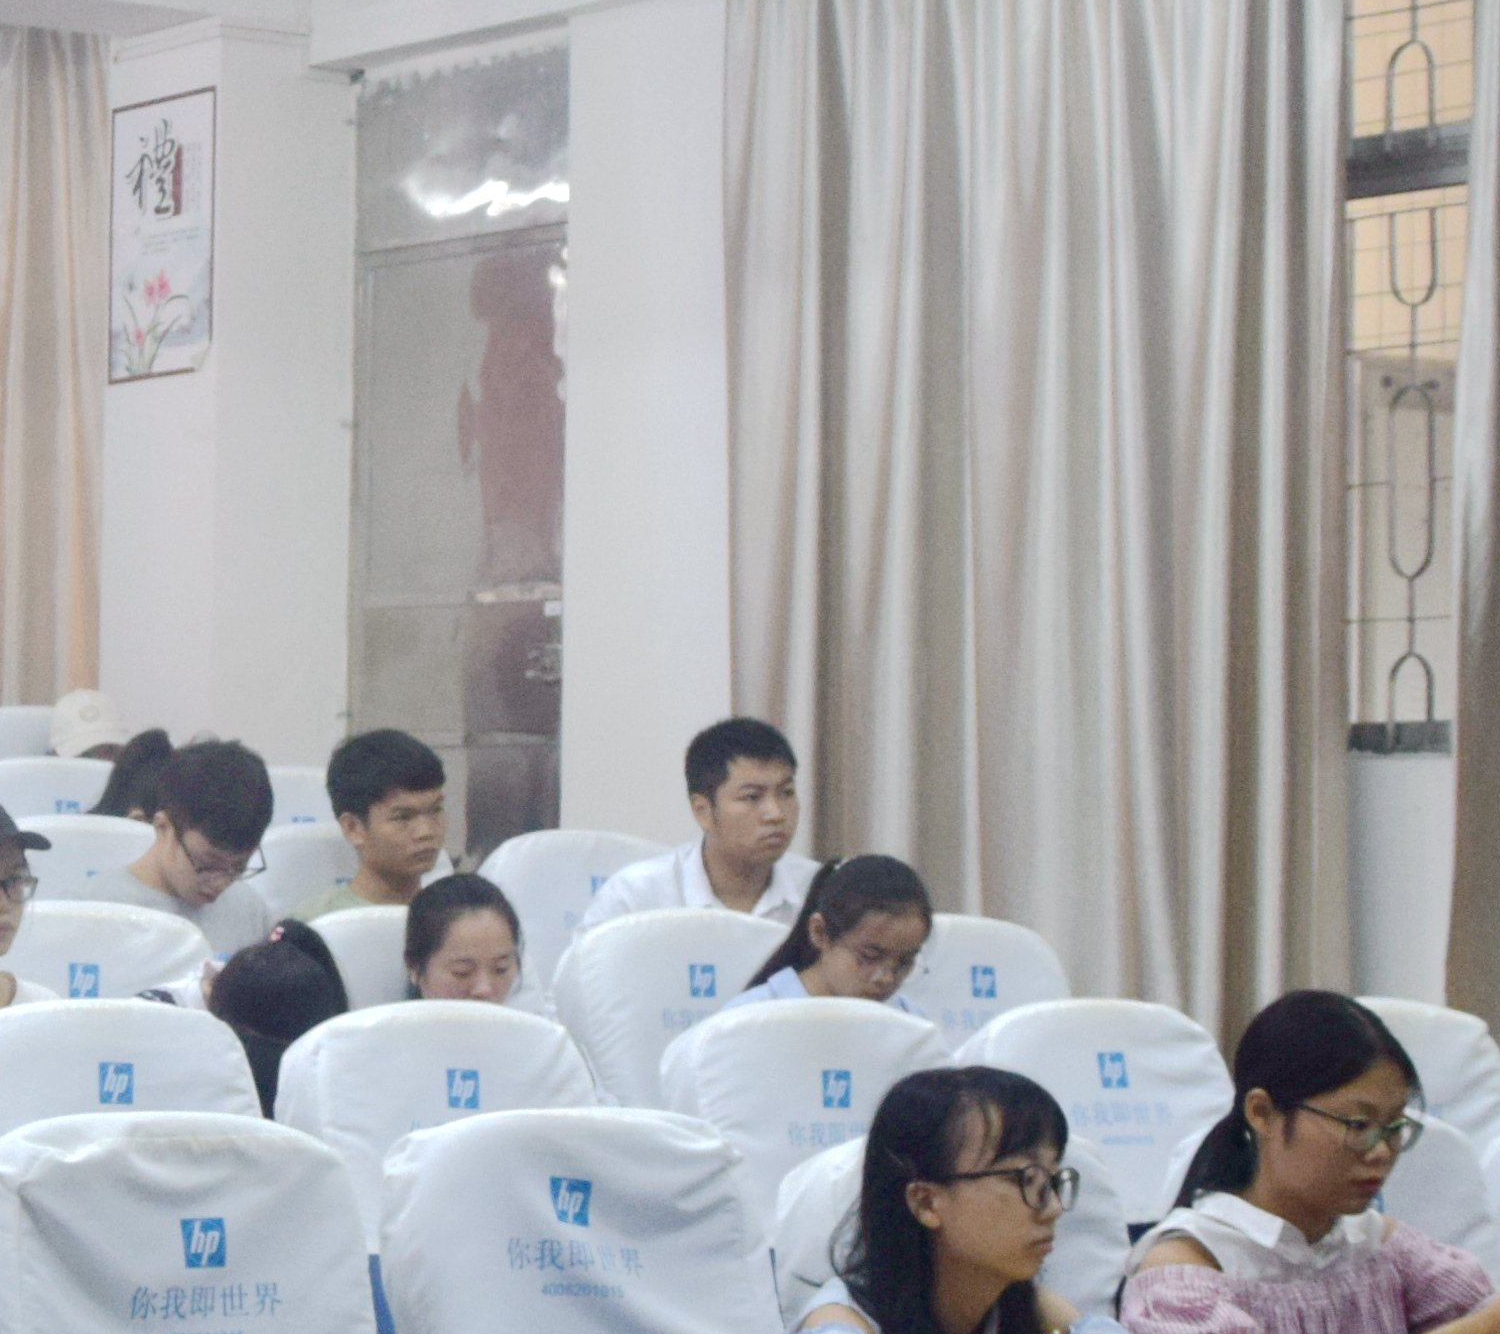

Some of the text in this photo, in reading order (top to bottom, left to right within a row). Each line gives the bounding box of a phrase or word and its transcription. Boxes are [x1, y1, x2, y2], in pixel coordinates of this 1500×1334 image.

[73, 964, 96, 997] hp
[104, 1064, 130, 1103] hp
[451, 1070, 476, 1108] hp
[554, 1177, 588, 1226] hp
[187, 1219, 221, 1267] hp
[507, 1236, 646, 1276] 你我即世界
[129, 1283, 282, 1321] 你我即世界
